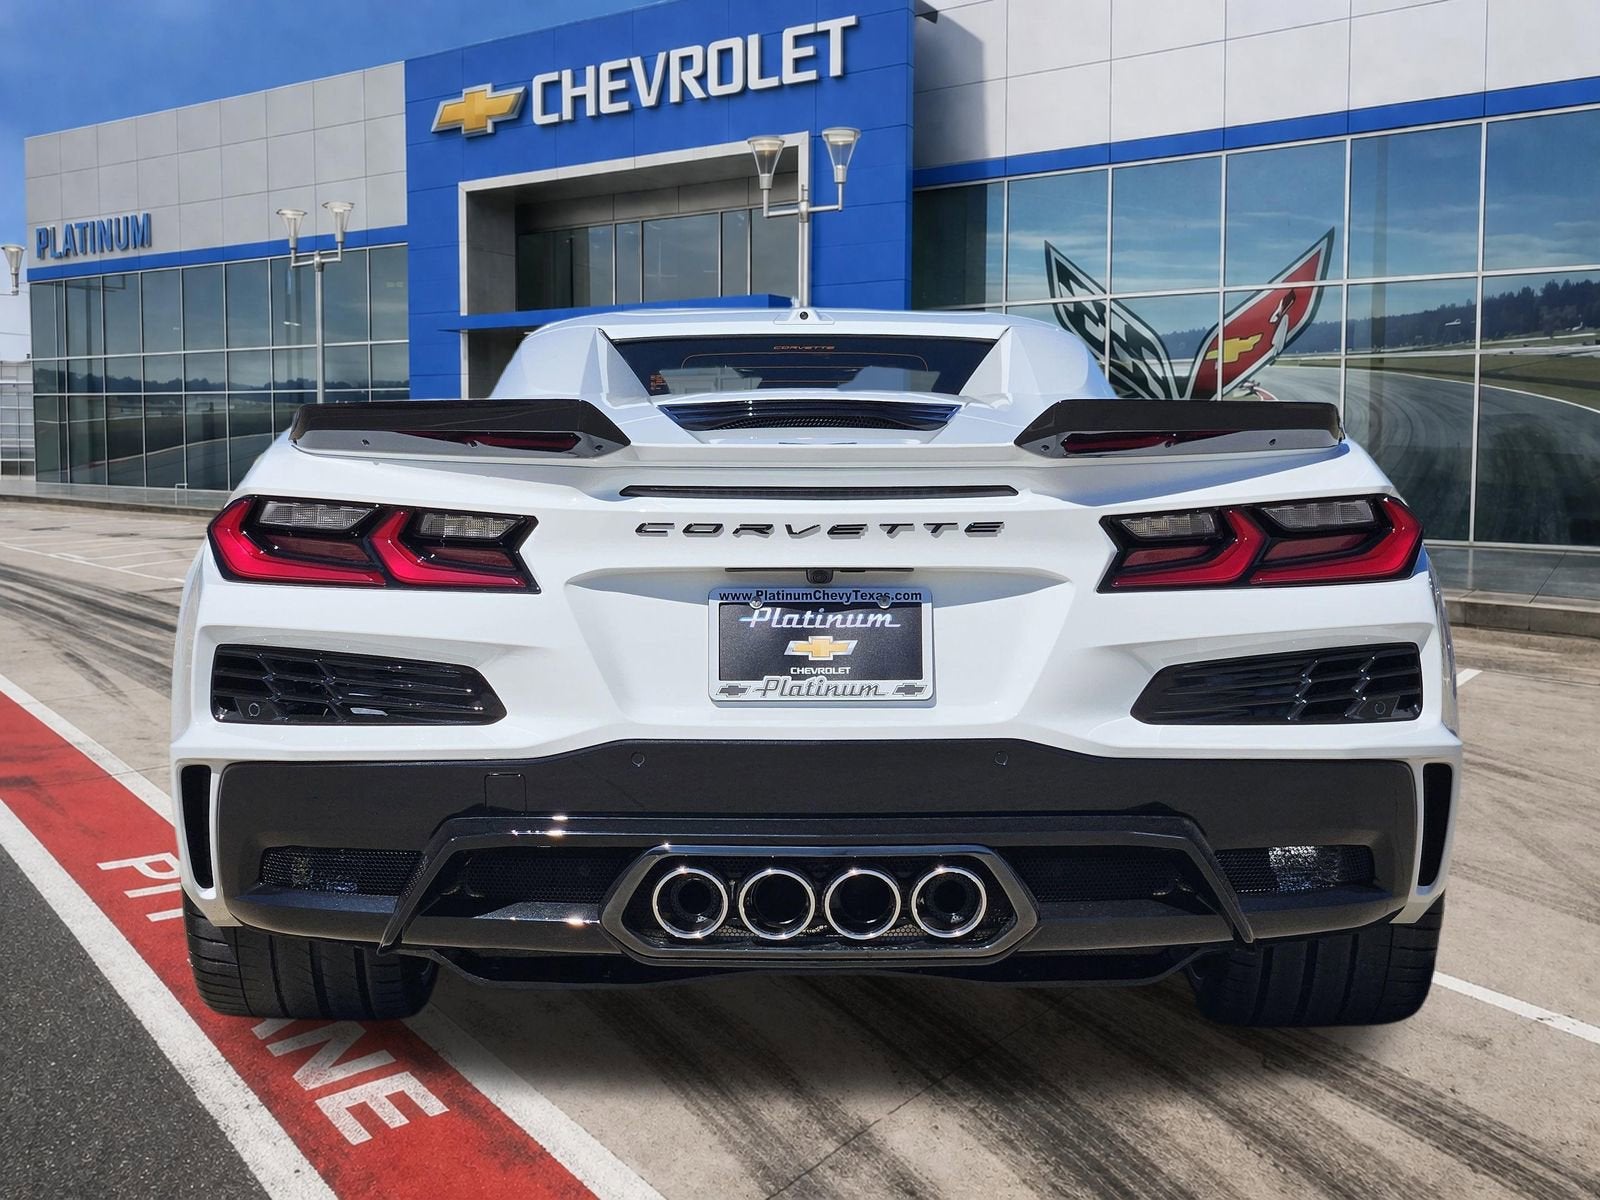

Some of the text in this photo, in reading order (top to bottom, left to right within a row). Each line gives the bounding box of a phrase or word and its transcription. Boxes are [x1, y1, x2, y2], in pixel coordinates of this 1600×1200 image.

[531, 15, 858, 126] CHEVROLET
[36, 212, 152, 260] PLATINUM
[635, 521, 1005, 539] CORVETTE
[719, 590, 922, 602] wwwPlatinumChevyTexas.com
[739, 608, 901, 628] Platinum
[790, 667, 851, 675] CHEVROLET
[753, 679, 889, 697] Platinum
